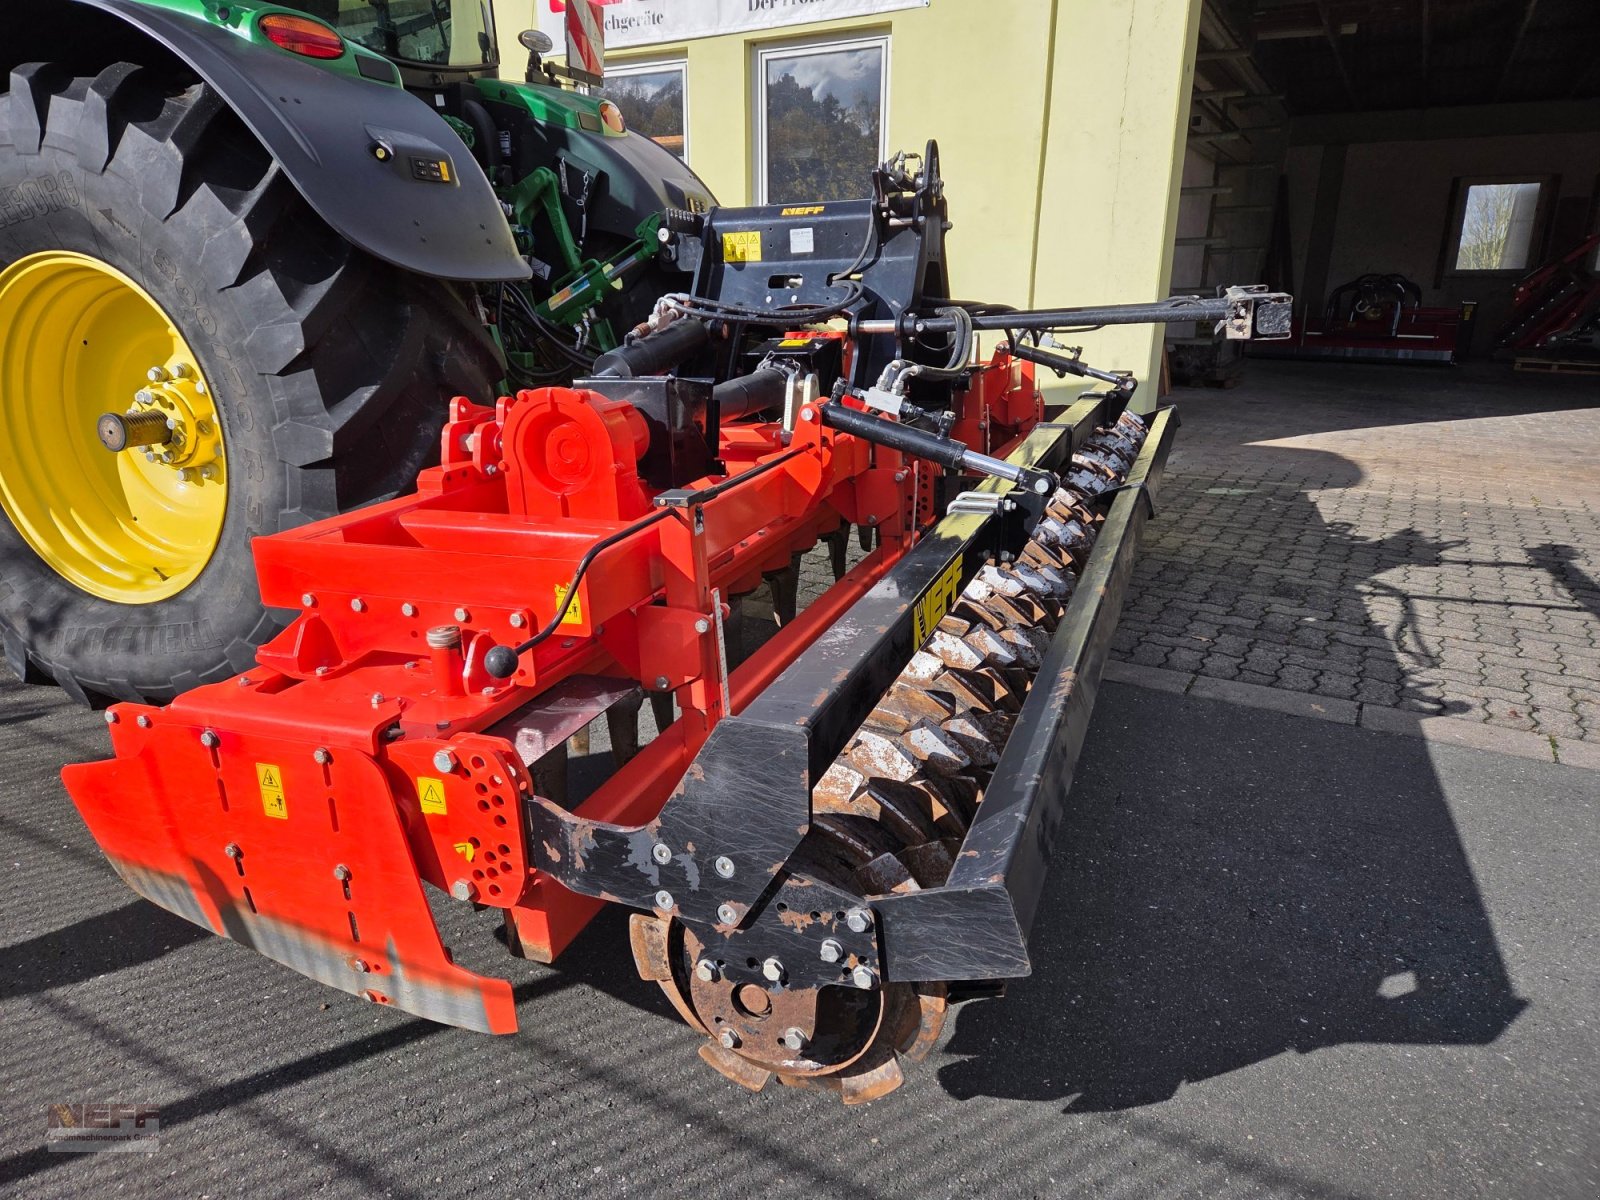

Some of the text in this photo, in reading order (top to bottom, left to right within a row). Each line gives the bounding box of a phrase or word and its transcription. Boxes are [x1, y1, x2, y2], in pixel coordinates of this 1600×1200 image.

[748, 0, 777, 11] Der
[0, 168, 80, 230] EBORG
[781, 206, 825, 216] NEFF
[913, 552, 963, 653] NEFF
